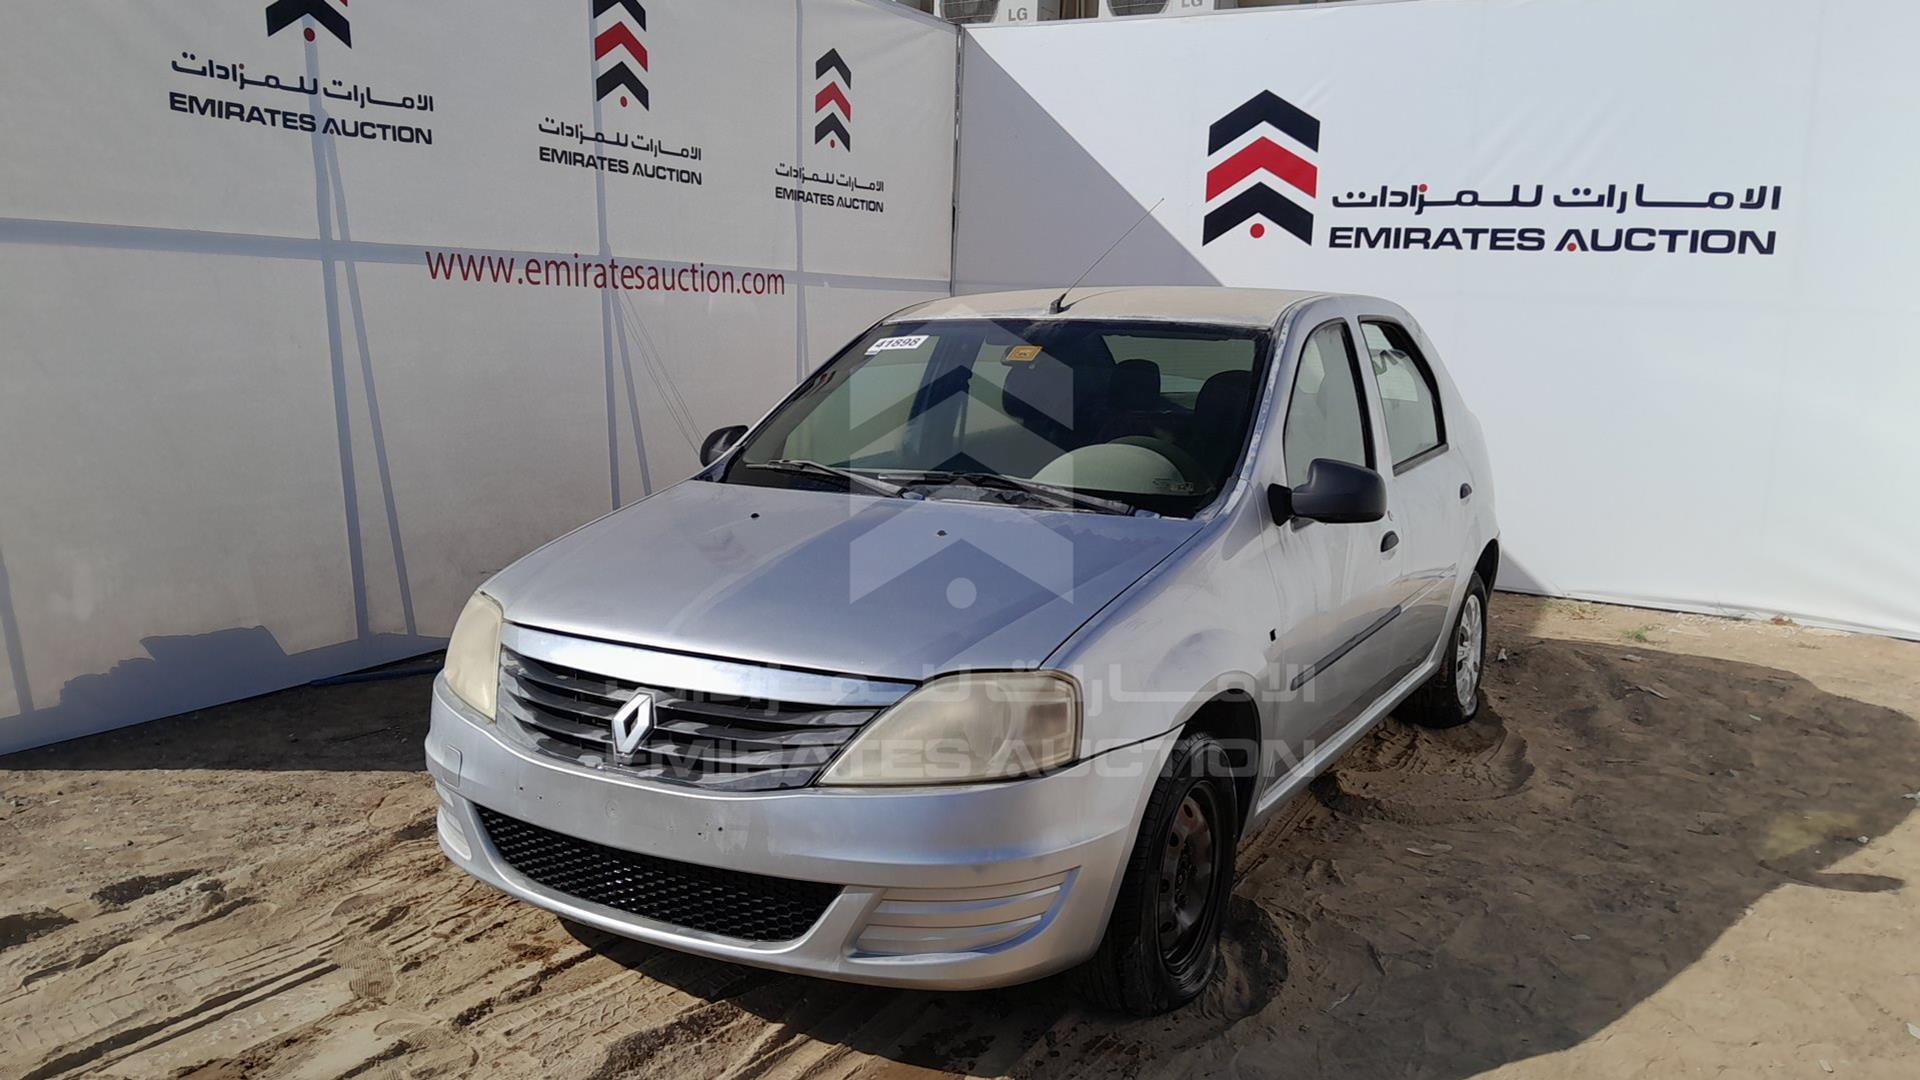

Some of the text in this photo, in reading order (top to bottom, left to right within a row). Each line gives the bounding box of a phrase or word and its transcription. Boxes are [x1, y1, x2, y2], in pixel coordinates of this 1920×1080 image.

[1008, 7, 1028, 22] LG
[171, 51, 434, 112] الامارات للمزادات
[169, 91, 433, 145] EMIRATES AUCTION
[538, 117, 702, 161] الامارات للمزادات
[539, 146, 702, 186] EMIRATES AUCTION
[775, 186, 884, 213] EMIRATES AUCTION
[1331, 184, 1782, 215] الامارات للمزادات
[1328, 226, 1777, 255] EMIRATES AUCTION
[425, 250, 786, 296] www.emiratesauction.com
[875, 338, 921, 348] 41898
